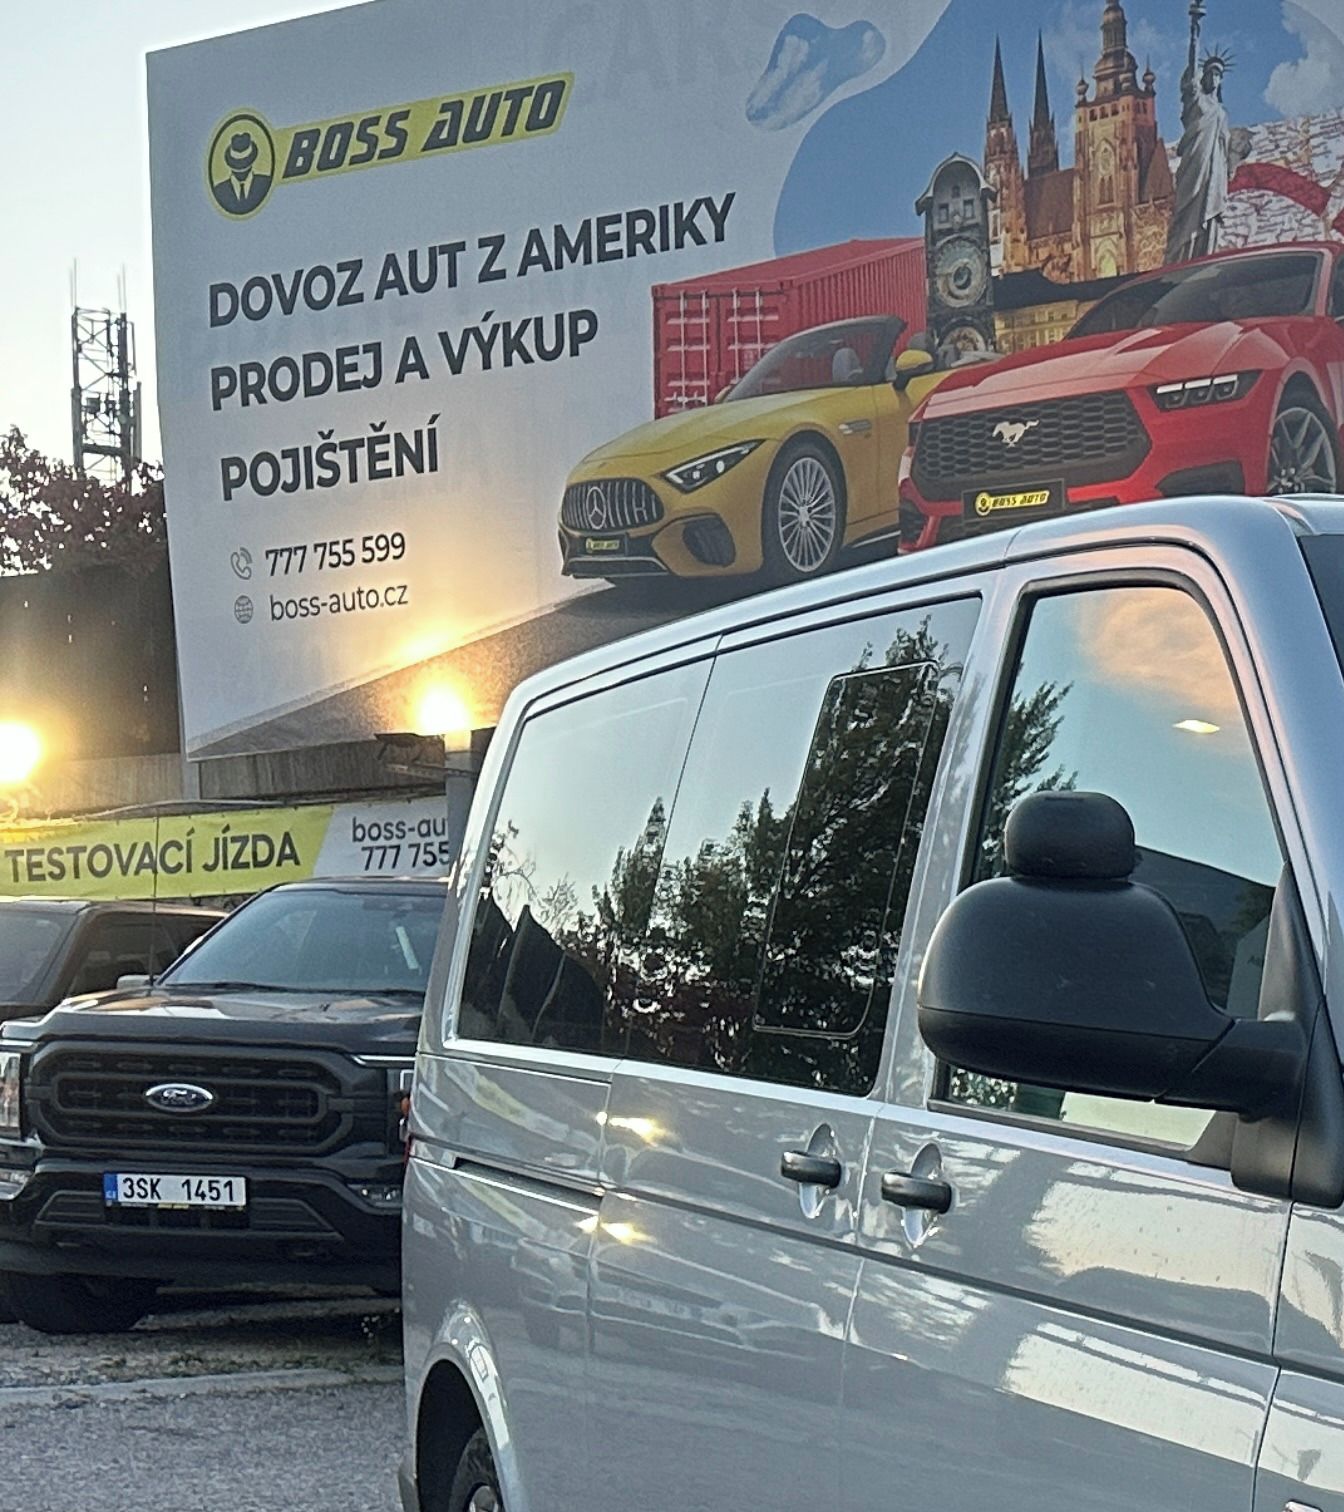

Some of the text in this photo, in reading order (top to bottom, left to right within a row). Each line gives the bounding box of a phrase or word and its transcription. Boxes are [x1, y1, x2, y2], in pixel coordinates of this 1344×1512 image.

[281, 79, 566, 179] BOSS AUTO
[209, 191, 736, 328] DOVOZ AUT Z AMERIKY
[210, 309, 599, 411] PRODEJ A VÝKUP
[220, 412, 441, 501] POJIŠTĚNÍ
[265, 532, 406, 577] 777 755 599
[269, 584, 409, 622] boss-auto.cz
[4, 823, 301, 883] TESTOVACÍ JÍZDA
[360, 841, 449, 871] 777 755
[122, 1177, 162, 1200] 3SK
[181, 1178, 234, 1202] 1451
